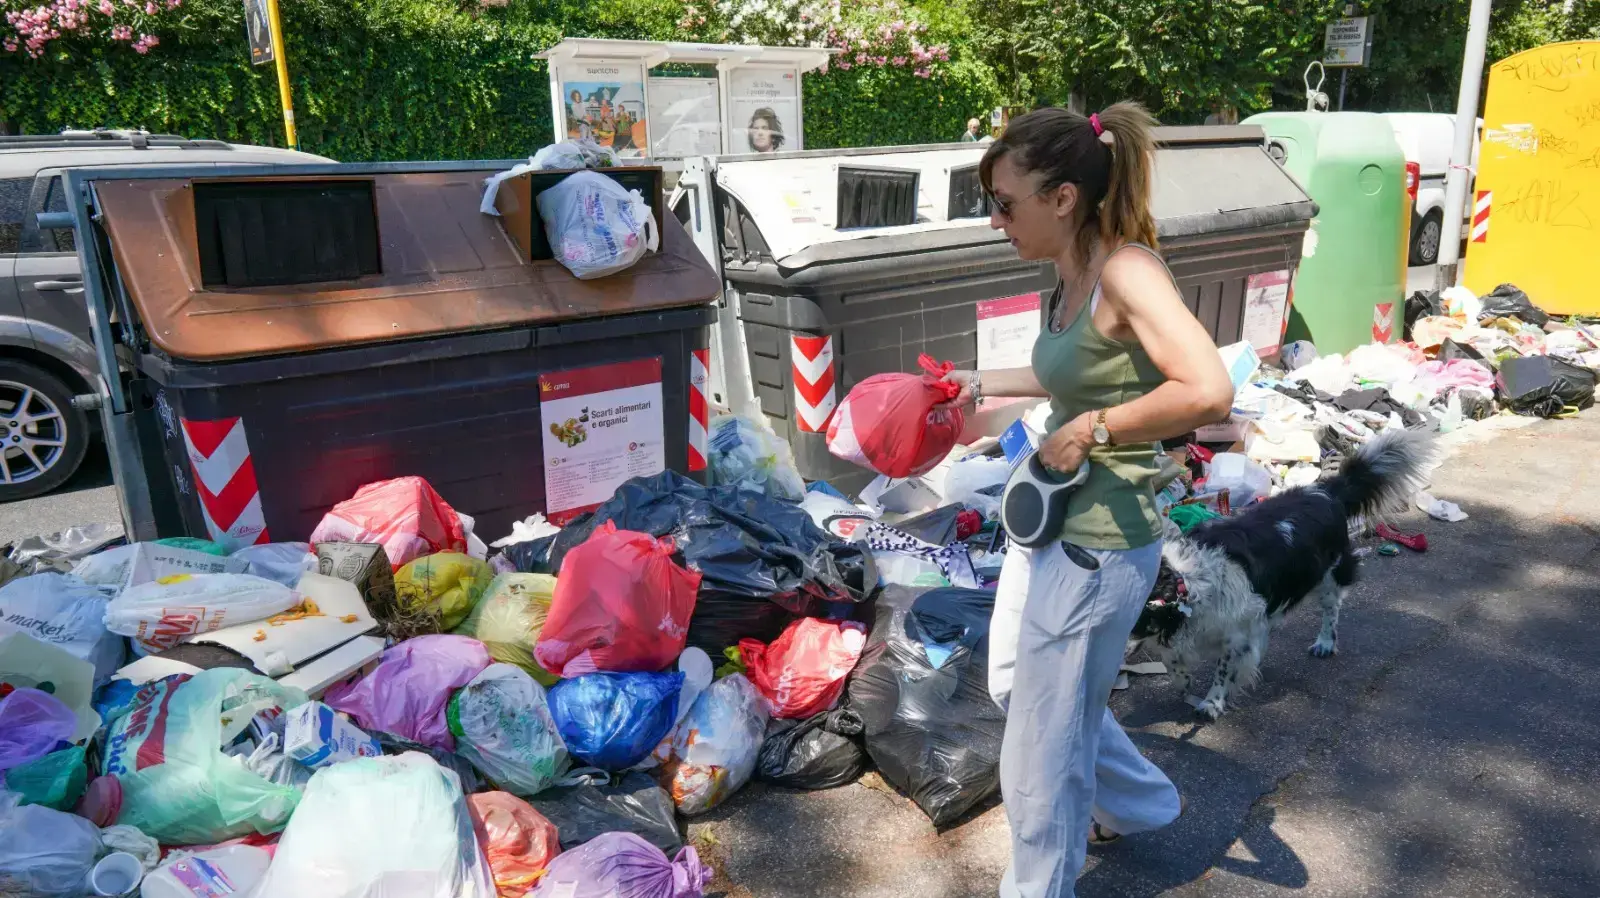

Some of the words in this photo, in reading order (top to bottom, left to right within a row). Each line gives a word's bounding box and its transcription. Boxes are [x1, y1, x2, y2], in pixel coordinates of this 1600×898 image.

[591, 408, 613, 419] Scarti
[614, 401, 651, 414] alimentari
[598, 415, 628, 428] organici
[4, 613, 66, 636] market
